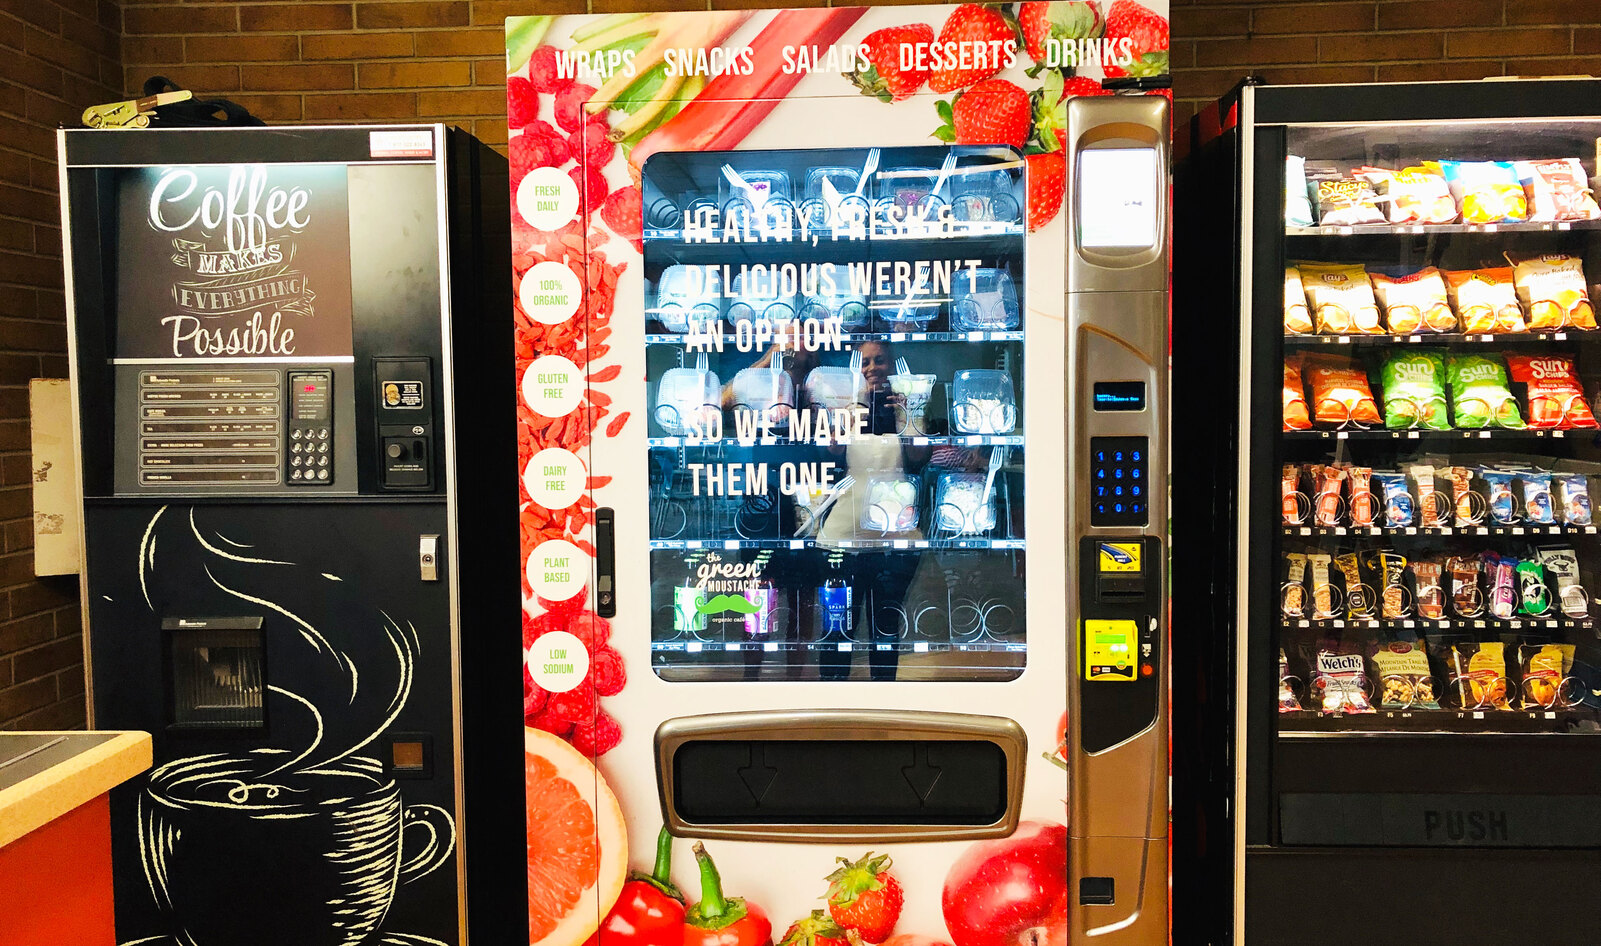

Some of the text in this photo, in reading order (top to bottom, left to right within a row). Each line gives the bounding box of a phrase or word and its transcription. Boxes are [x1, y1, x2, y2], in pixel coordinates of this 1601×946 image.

[555, 37, 1133, 79] WRAPS SNACKS SALADS DESSERTS DRINKS
[535, 185, 561, 197] FRESH
[150, 166, 311, 254] Coffee
[537, 200, 560, 212] DAILY
[684, 204, 955, 247] HEALTHY, FRESH &
[197, 244, 283, 274] MAKES
[685, 259, 982, 298] DELICIOUS WEREN'T
[539, 280, 562, 291] 100%
[180, 279, 300, 310] EVERYTHING
[533, 295, 568, 306] ORGANIC
[161, 311, 296, 357] Possible
[686, 317, 852, 353] AN OPTION.
[1394, 361, 1434, 382] Sun
[1459, 364, 1499, 383] Sun
[1529, 360, 1566, 379] Sun
[537, 373, 568, 384] GLUTEN
[543, 388, 564, 398] FREE
[687, 407, 870, 443] SO WE MADE
[1098, 451, 1140, 461] 1 2 3
[543, 466, 567, 476] DAIRY
[1098, 469, 1140, 478] 4 5 6
[687, 461, 846, 497] THEM ONE.
[545, 481, 566, 491] FREE
[1098, 486, 1140, 496] 7 8 9
[1115, 503, 1122, 512] 0
[544, 557, 569, 568] PLANT
[706, 551, 722, 563] the
[544, 572, 570, 582] BASED
[695, 562, 761, 590] green
[707, 580, 761, 592] MOUSTACHE
[549, 649, 567, 659] LOW
[543, 664, 574, 674] SODIUM
[1320, 656, 1361, 670] Welch's
[1424, 810, 1508, 841] PUSH
